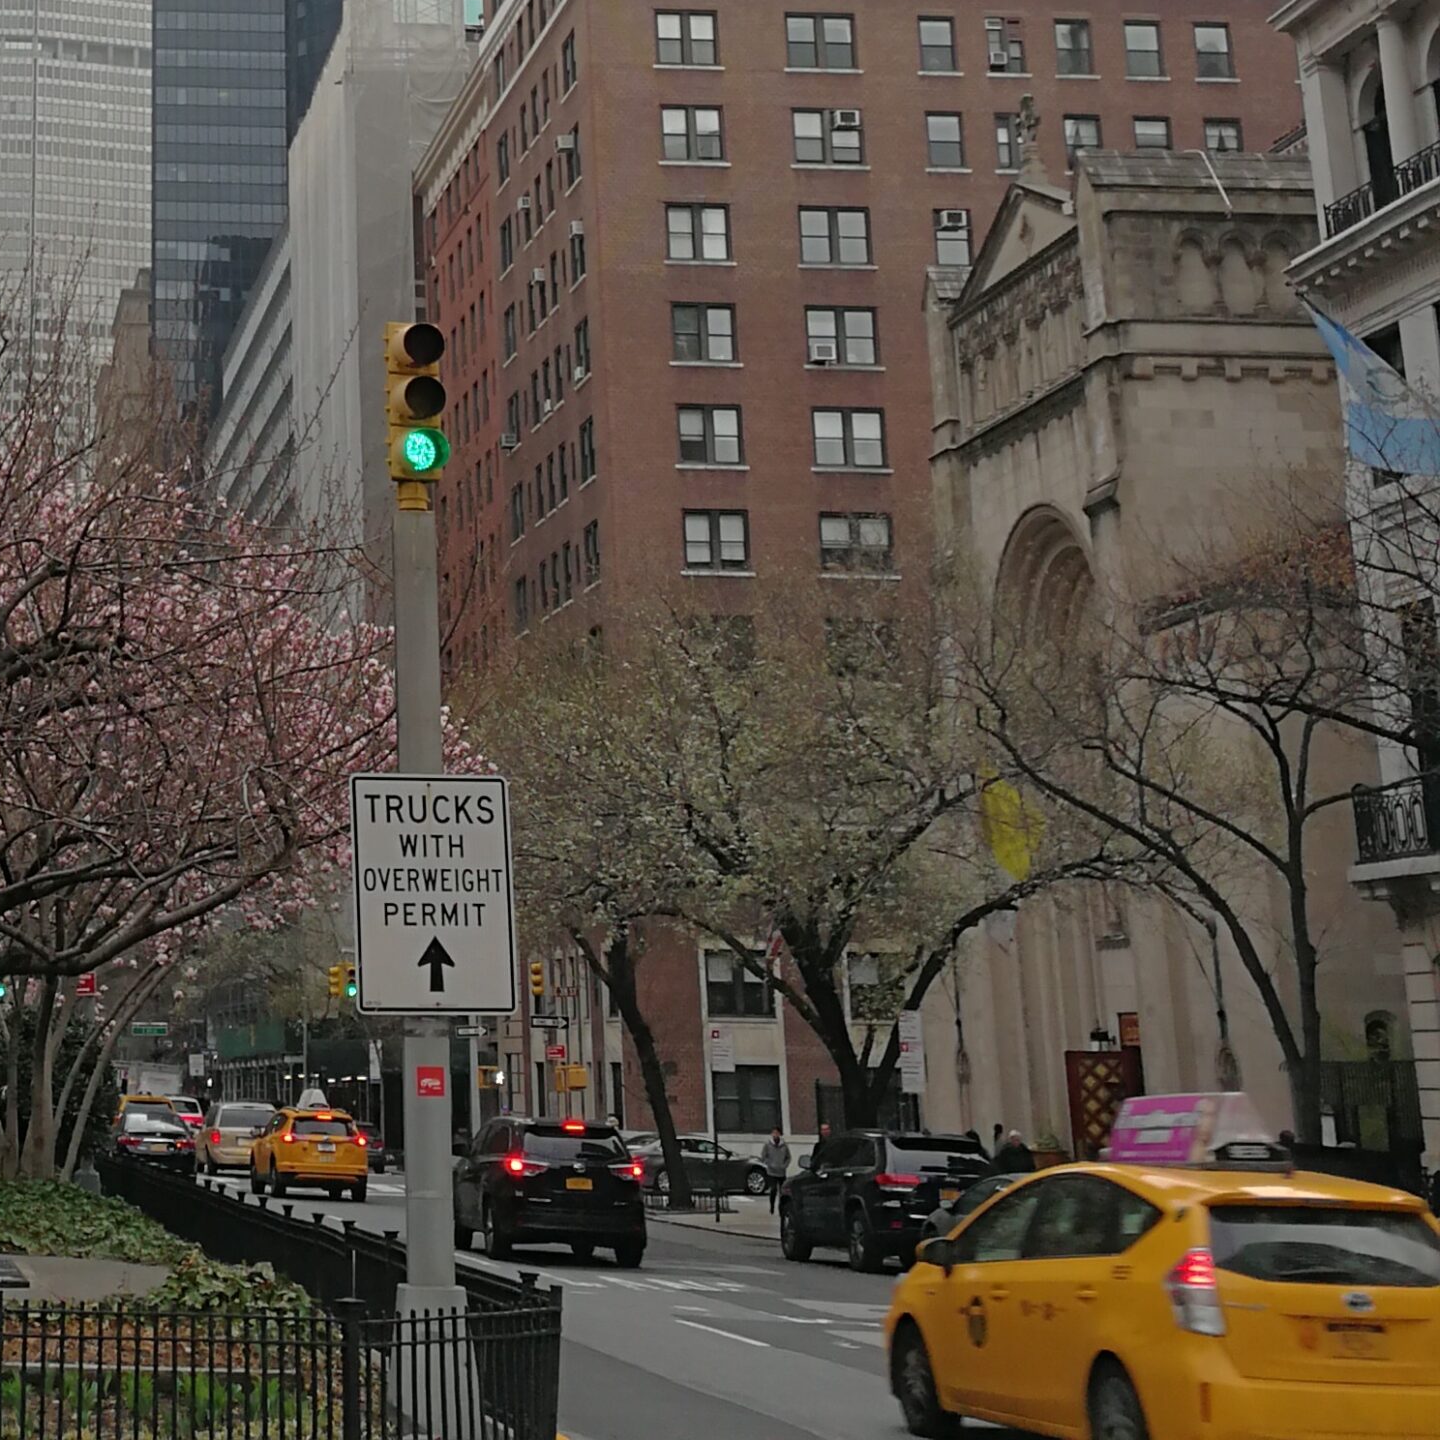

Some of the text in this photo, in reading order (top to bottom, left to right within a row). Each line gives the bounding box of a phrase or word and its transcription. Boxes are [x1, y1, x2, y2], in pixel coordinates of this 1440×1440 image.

[364, 795, 494, 824] TRUCKS
[399, 834, 464, 858] WITH
[364, 868, 503, 892] OVERWEIGHT
[384, 903, 486, 926] PERMIT
